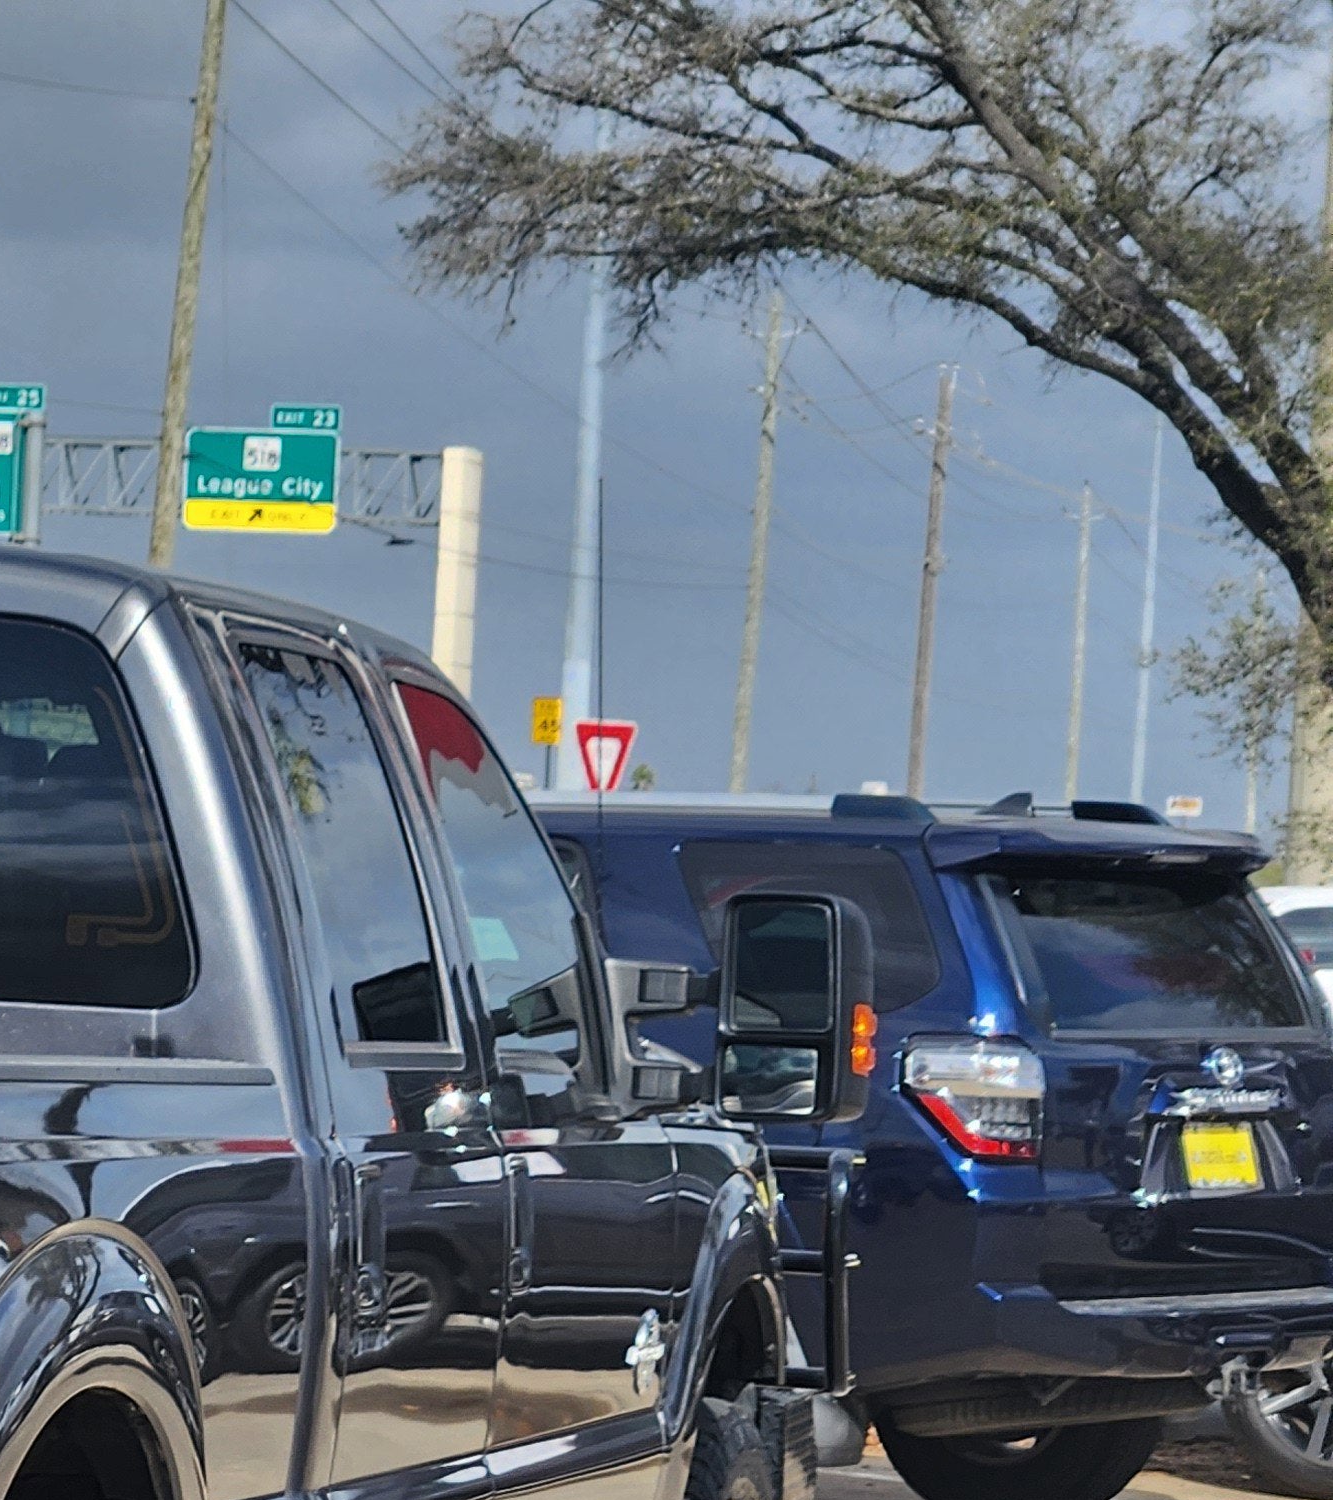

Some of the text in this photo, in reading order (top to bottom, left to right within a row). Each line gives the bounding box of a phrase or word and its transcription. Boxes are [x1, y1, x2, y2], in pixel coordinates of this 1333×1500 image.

[275, 409, 336, 428] EXIT 23
[196, 474, 324, 501] League City
